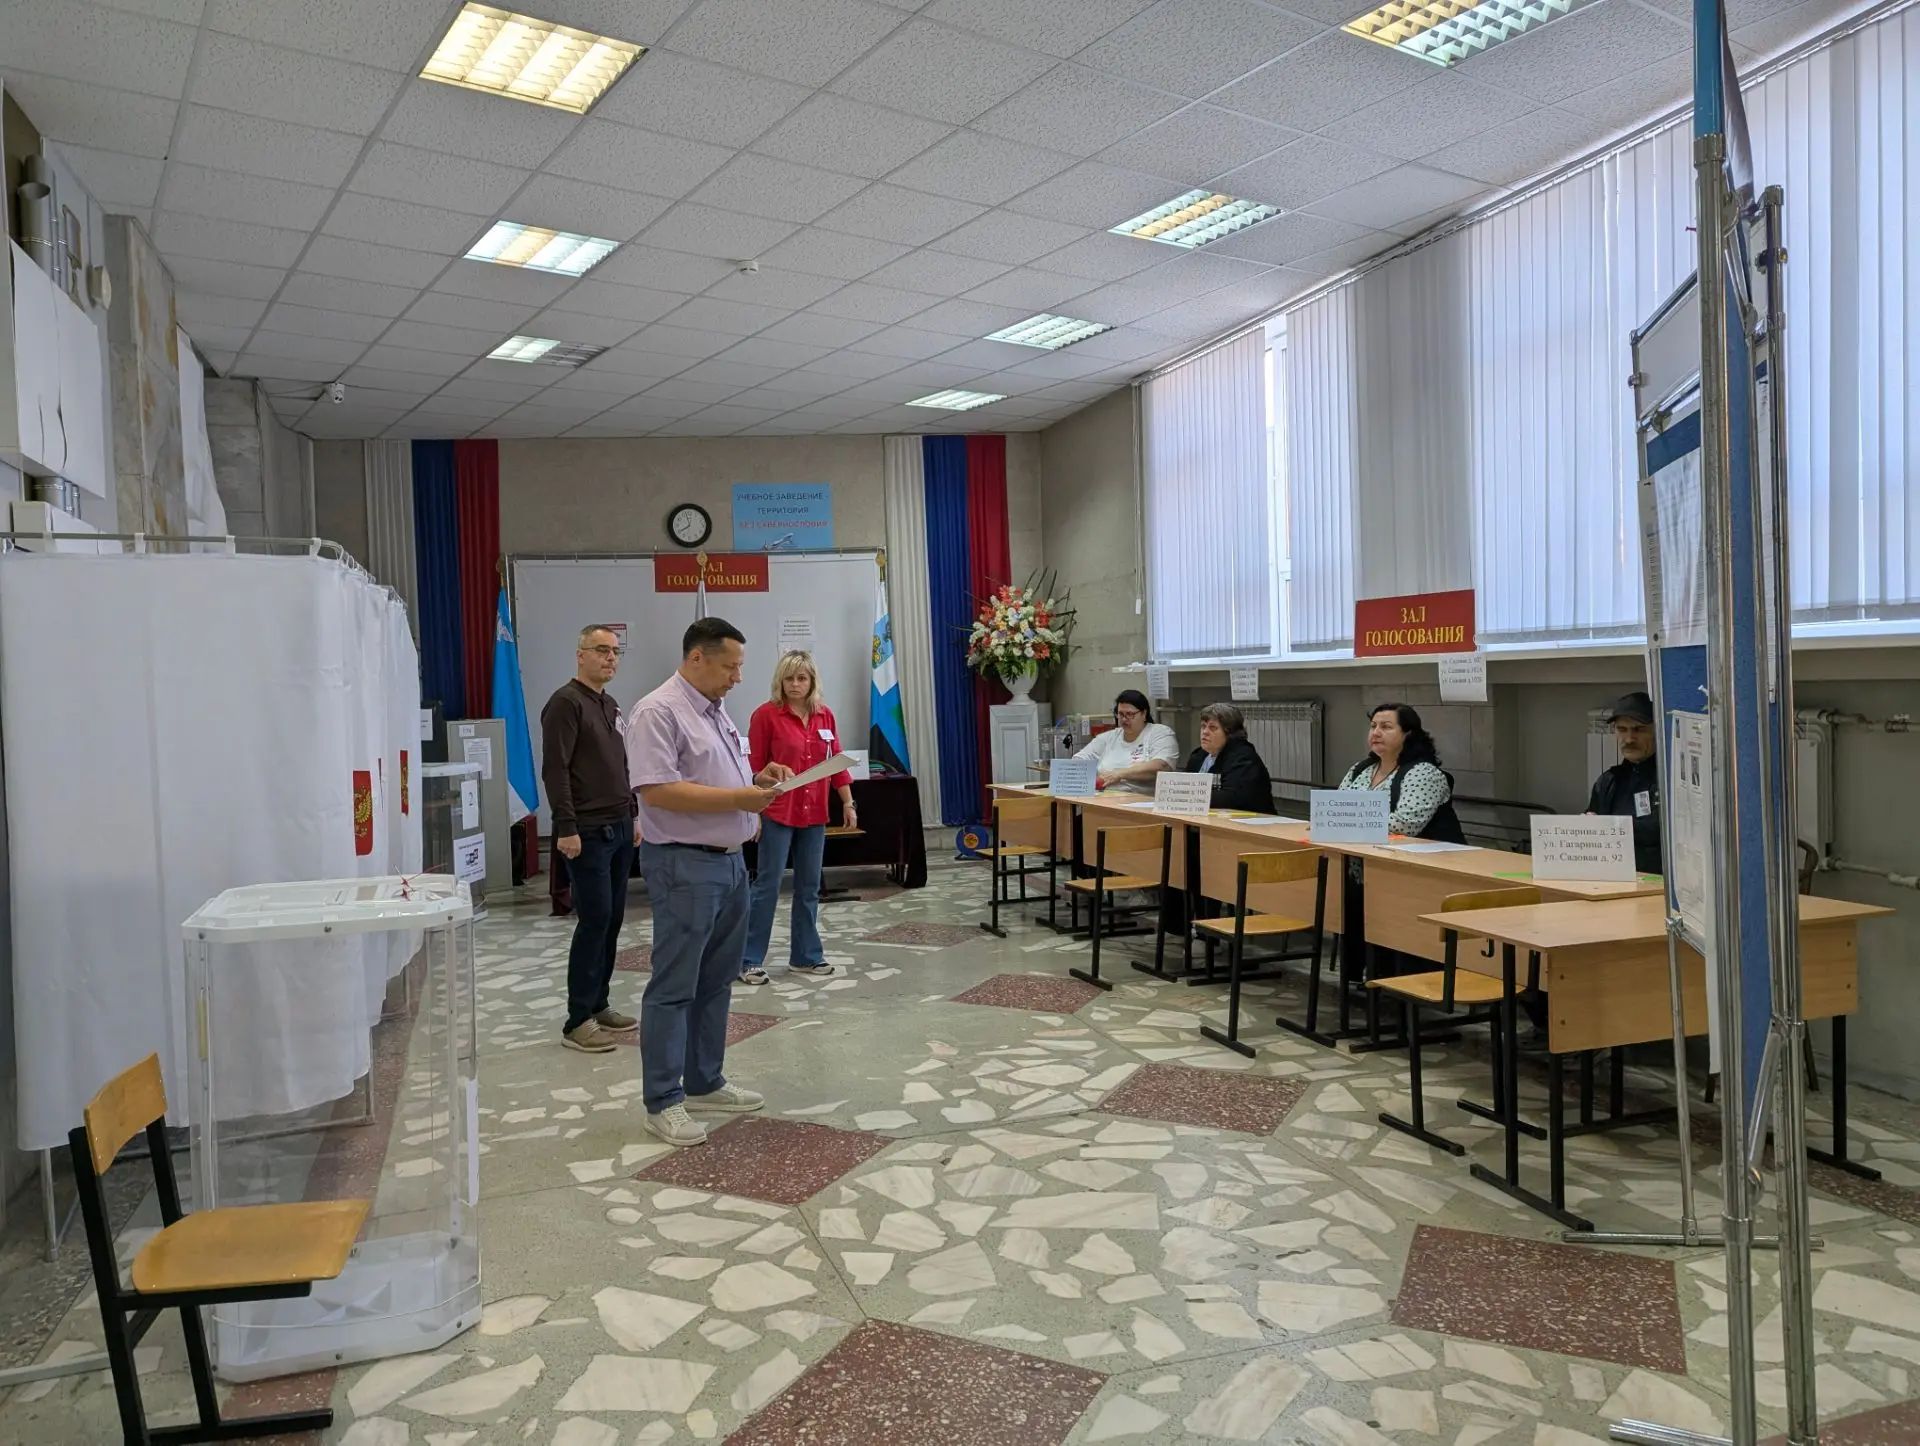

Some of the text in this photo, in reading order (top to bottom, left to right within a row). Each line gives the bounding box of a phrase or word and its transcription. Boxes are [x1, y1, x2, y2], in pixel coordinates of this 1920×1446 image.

[736, 493, 774, 501] УЧЕБНОЕ
[776, 493, 824, 501] ЗАВЕДЕНИЕ
[758, 507, 809, 515] ТЕРРИТОРИЯ
[667, 574, 759, 586] ГОЛООВАНИЯ
[1400, 606, 1426, 623] ЗАЛ
[1365, 625, 1465, 647] ГОЛОСОВАНИЯ
[1538, 828, 1552, 837] ул.
[1555, 827, 1597, 837] Гагарина
[1610, 827, 1616, 836] 2
[1619, 828, 1626, 836] Б
[1543, 841, 1556, 849] ул.
[1560, 840, 1602, 849] Гагарина
[1544, 854, 1556, 862] ул.
[1559, 853, 1598, 861] Садовая
[1611, 854, 1623, 862] 92
